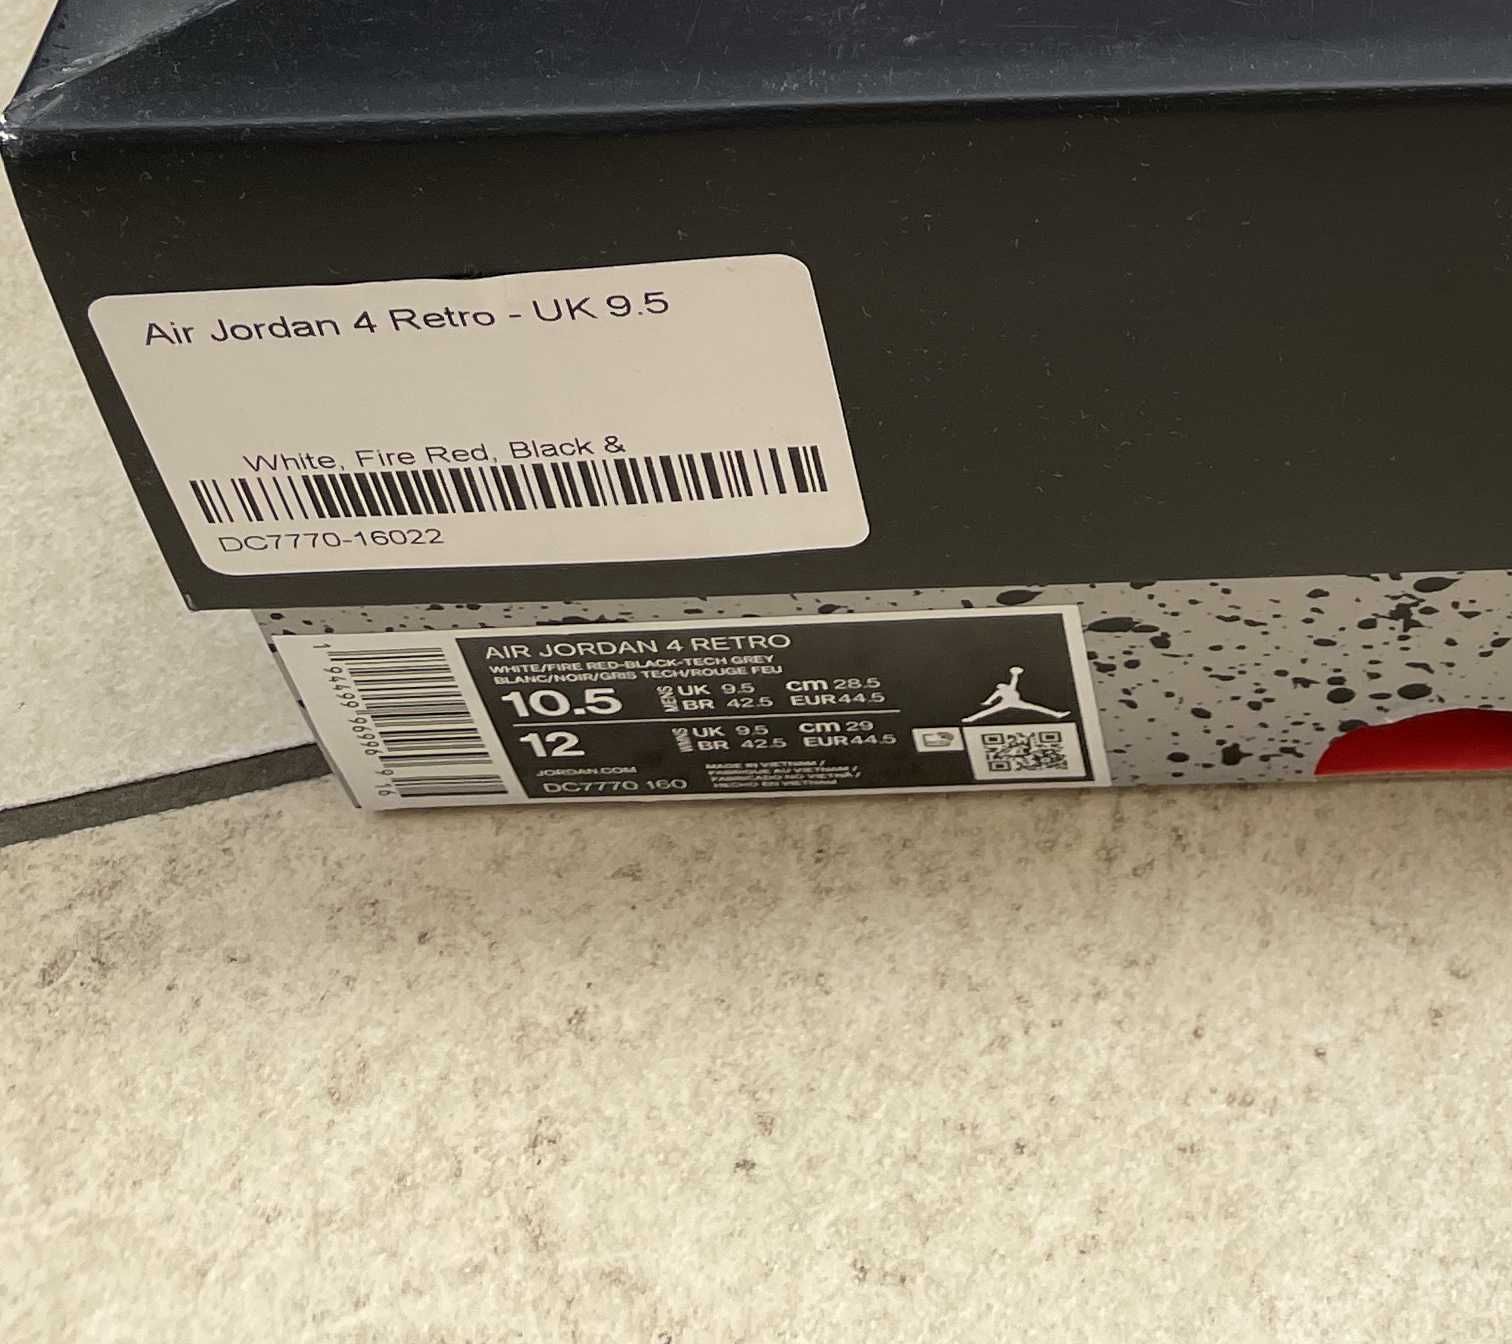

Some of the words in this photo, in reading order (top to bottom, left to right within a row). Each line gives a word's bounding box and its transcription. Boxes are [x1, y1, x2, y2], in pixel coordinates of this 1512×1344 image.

[144, 319, 195, 346] Air
[210, 311, 340, 343] Jordan
[354, 311, 377, 334] 4
[389, 303, 496, 332] Retro
[532, 295, 598, 324] UK
[606, 291, 670, 318] 9.5
[243, 450, 344, 473] White,
[356, 445, 415, 467] Fire
[425, 441, 498, 465] Red,
[510, 437, 594, 459] Black
[604, 434, 627, 453] &
[217, 528, 445, 553] DC7770-16022
[485, 645, 531, 659] AIR
[539, 640, 657, 658] JORDAN
[666, 639, 684, 652] 4
[691, 634, 792, 651] RETRO
[489, 662, 583, 674] WHITE/FIRE
[731, 655, 774, 665] GREY
[752, 665, 783, 675] FEU
[677, 684, 711, 697] UK
[721, 682, 755, 695] 9.5
[785, 679, 828, 692] cm
[833, 678, 881, 690] 28.5
[502, 687, 623, 718] 10.5
[682, 698, 715, 711] BR
[727, 696, 774, 709] 42.5
[790, 694, 836, 707] EUR
[838, 692, 885, 704] 44.5
[692, 726, 726, 738] UK
[735, 724, 769, 736] 9.5
[799, 722, 841, 733] cm
[845, 720, 874, 732] 29
[519, 731, 585, 758] 12
[697, 739, 730, 752] BR
[740, 737, 787, 749] 42.5
[803, 735, 848, 748] EUR
[849, 734, 897, 746] 44.5
[543, 780, 639, 793] DC7770
[646, 779, 688, 790] 160
